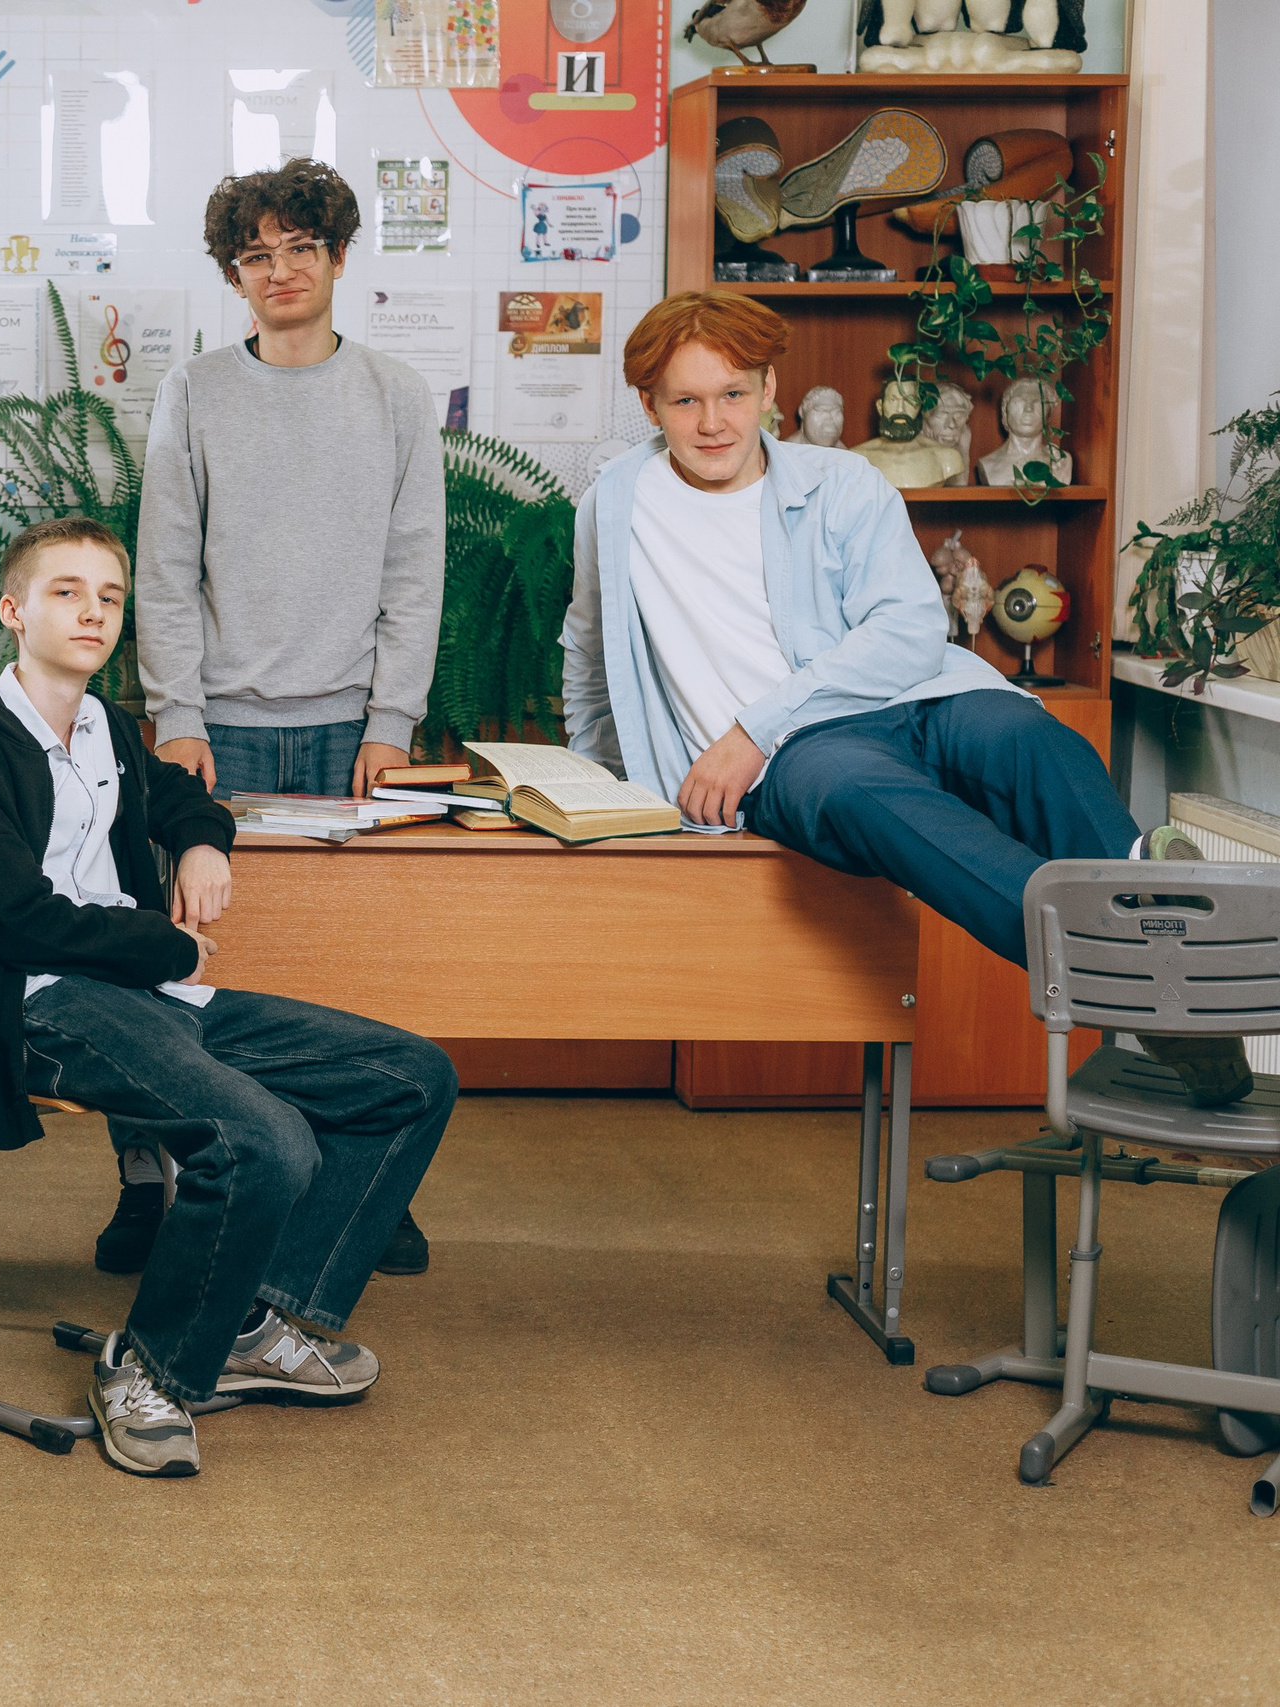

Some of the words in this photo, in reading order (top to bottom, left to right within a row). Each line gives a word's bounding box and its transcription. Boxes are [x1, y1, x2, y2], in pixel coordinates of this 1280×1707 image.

[560, 55, 601, 93] И
[370, 313, 439, 324] ГРАМОТА
[142, 329, 171, 338] БИТВА
[140, 345, 171, 354] ХОРОВ
[532, 343, 569, 354] ДИПЛОМ
